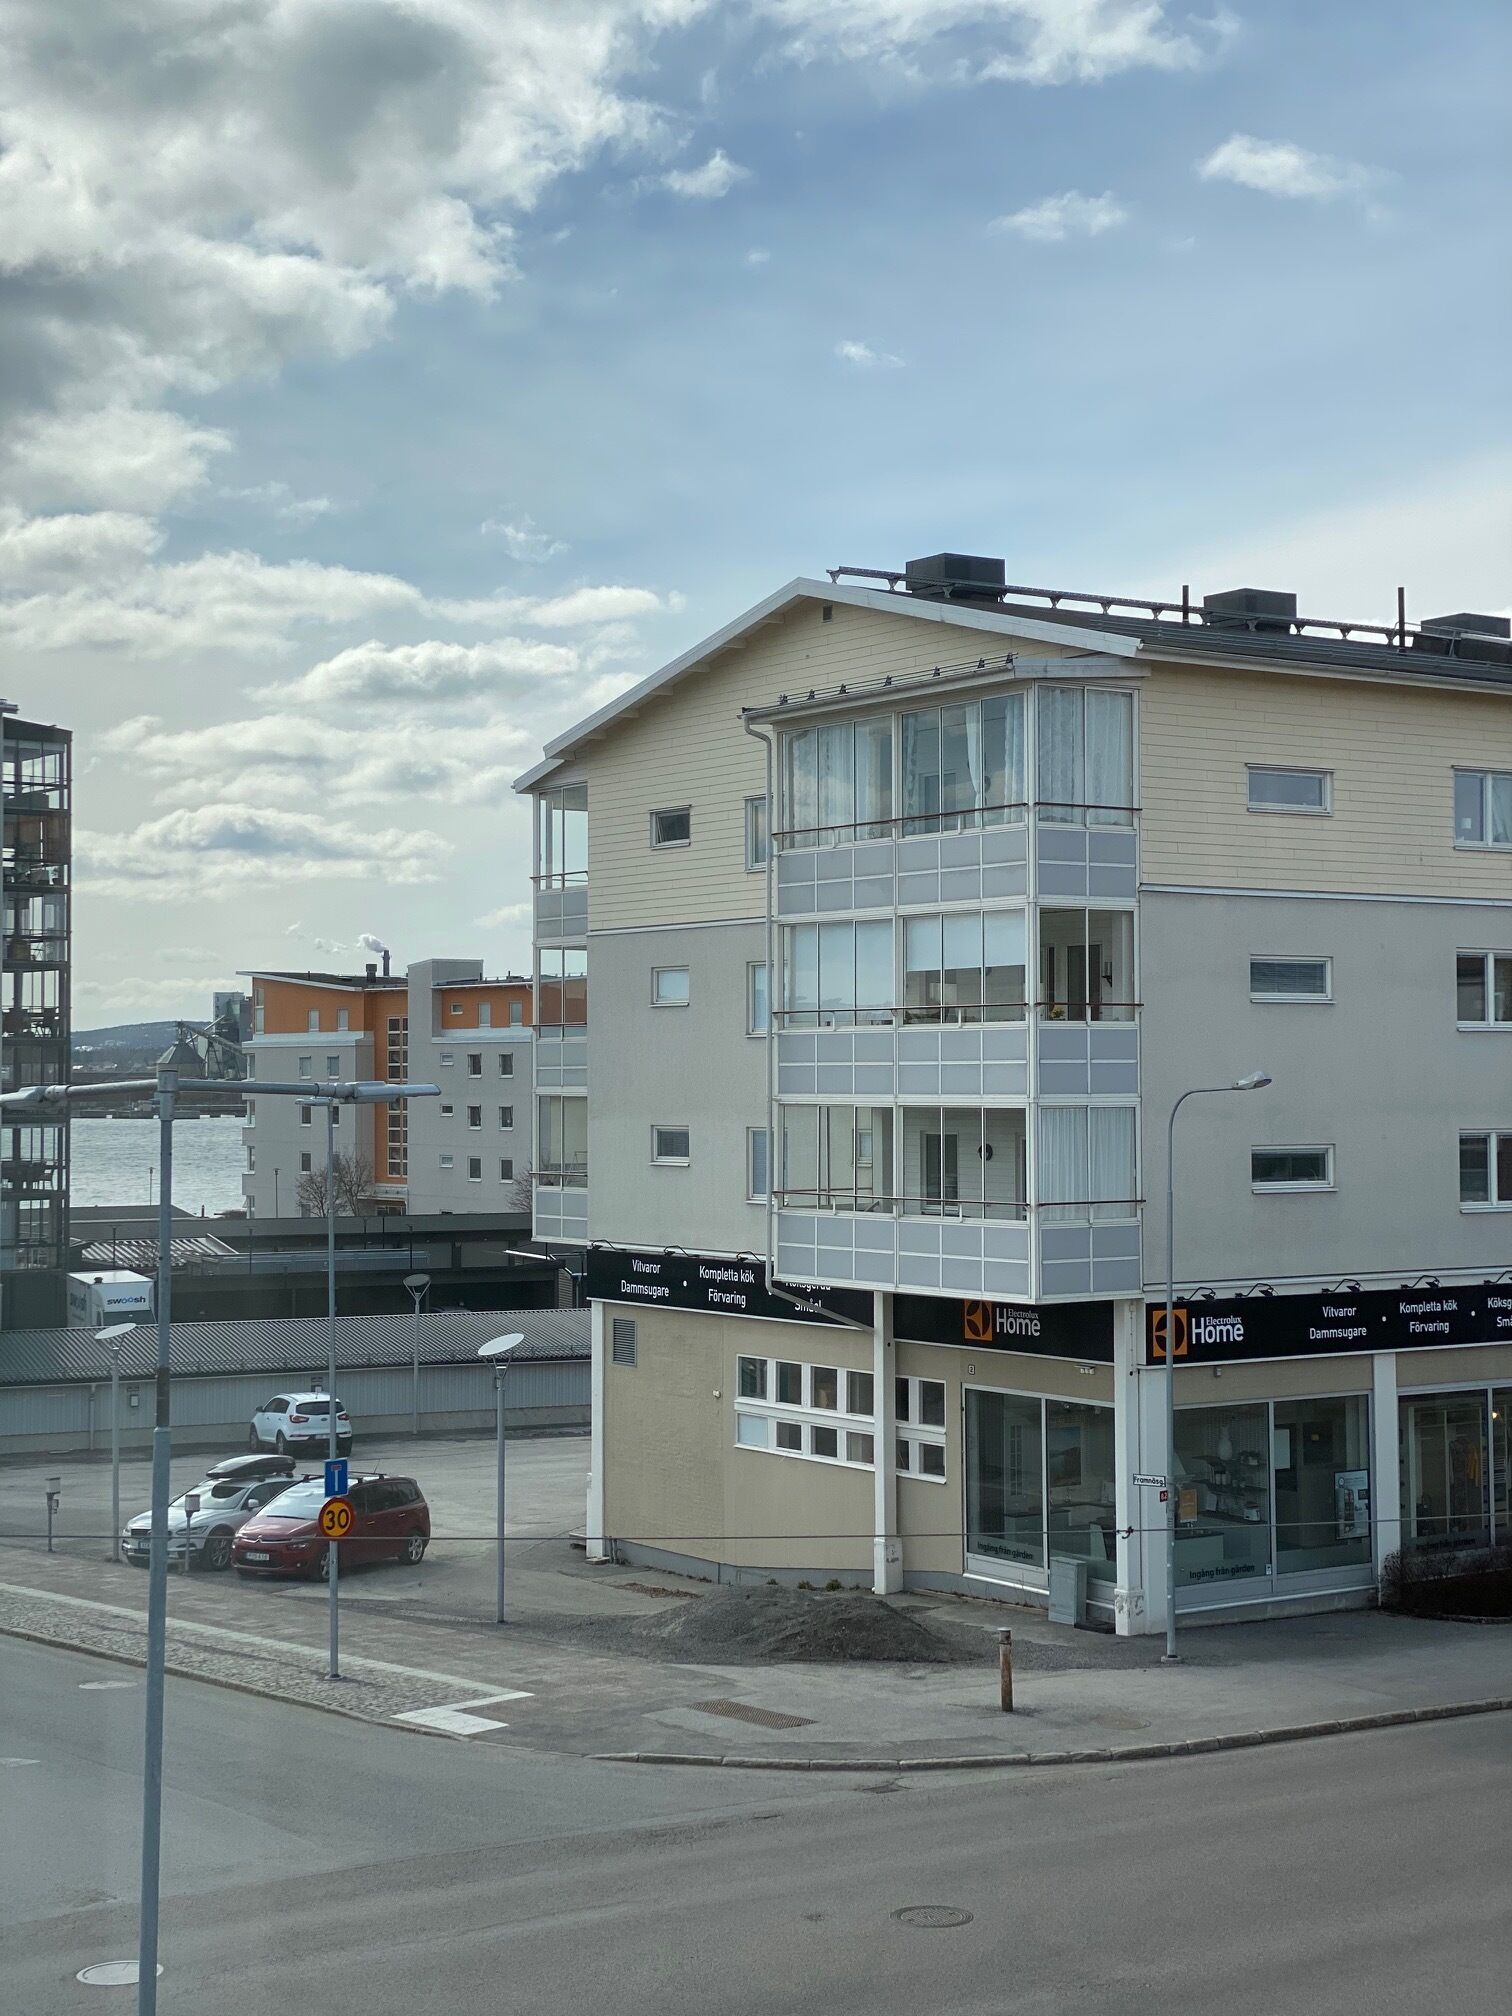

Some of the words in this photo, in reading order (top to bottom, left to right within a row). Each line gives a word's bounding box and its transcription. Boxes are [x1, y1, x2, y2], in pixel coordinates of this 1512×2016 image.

[632, 1259, 661, 1275] Vitvaror
[699, 1265, 739, 1283] Kompletta
[741, 1269, 755, 1284] kök
[620, 1279, 670, 1298] Dammsugare
[107, 1296, 146, 1306] swoosh
[708, 1288, 747, 1308] Förvaring
[1008, 1308, 1039, 1320] Electrolux
[1322, 1306, 1357, 1318] Vitvaror
[1399, 1301, 1442, 1315] Kompletta
[1443, 1299, 1458, 1311] kök
[996, 1307, 1041, 1337] Home
[1205, 1315, 1242, 1325] Electrolux
[1409, 1320, 1449, 1334] Förvaring
[1191, 1317, 1244, 1345] Home
[1309, 1326, 1367, 1341] Dammsugare
[325, 1508, 350, 1531] 30
[1189, 1568, 1215, 1580] Ingång
[1215, 1566, 1230, 1576] från
[1230, 1564, 1255, 1576] gården
